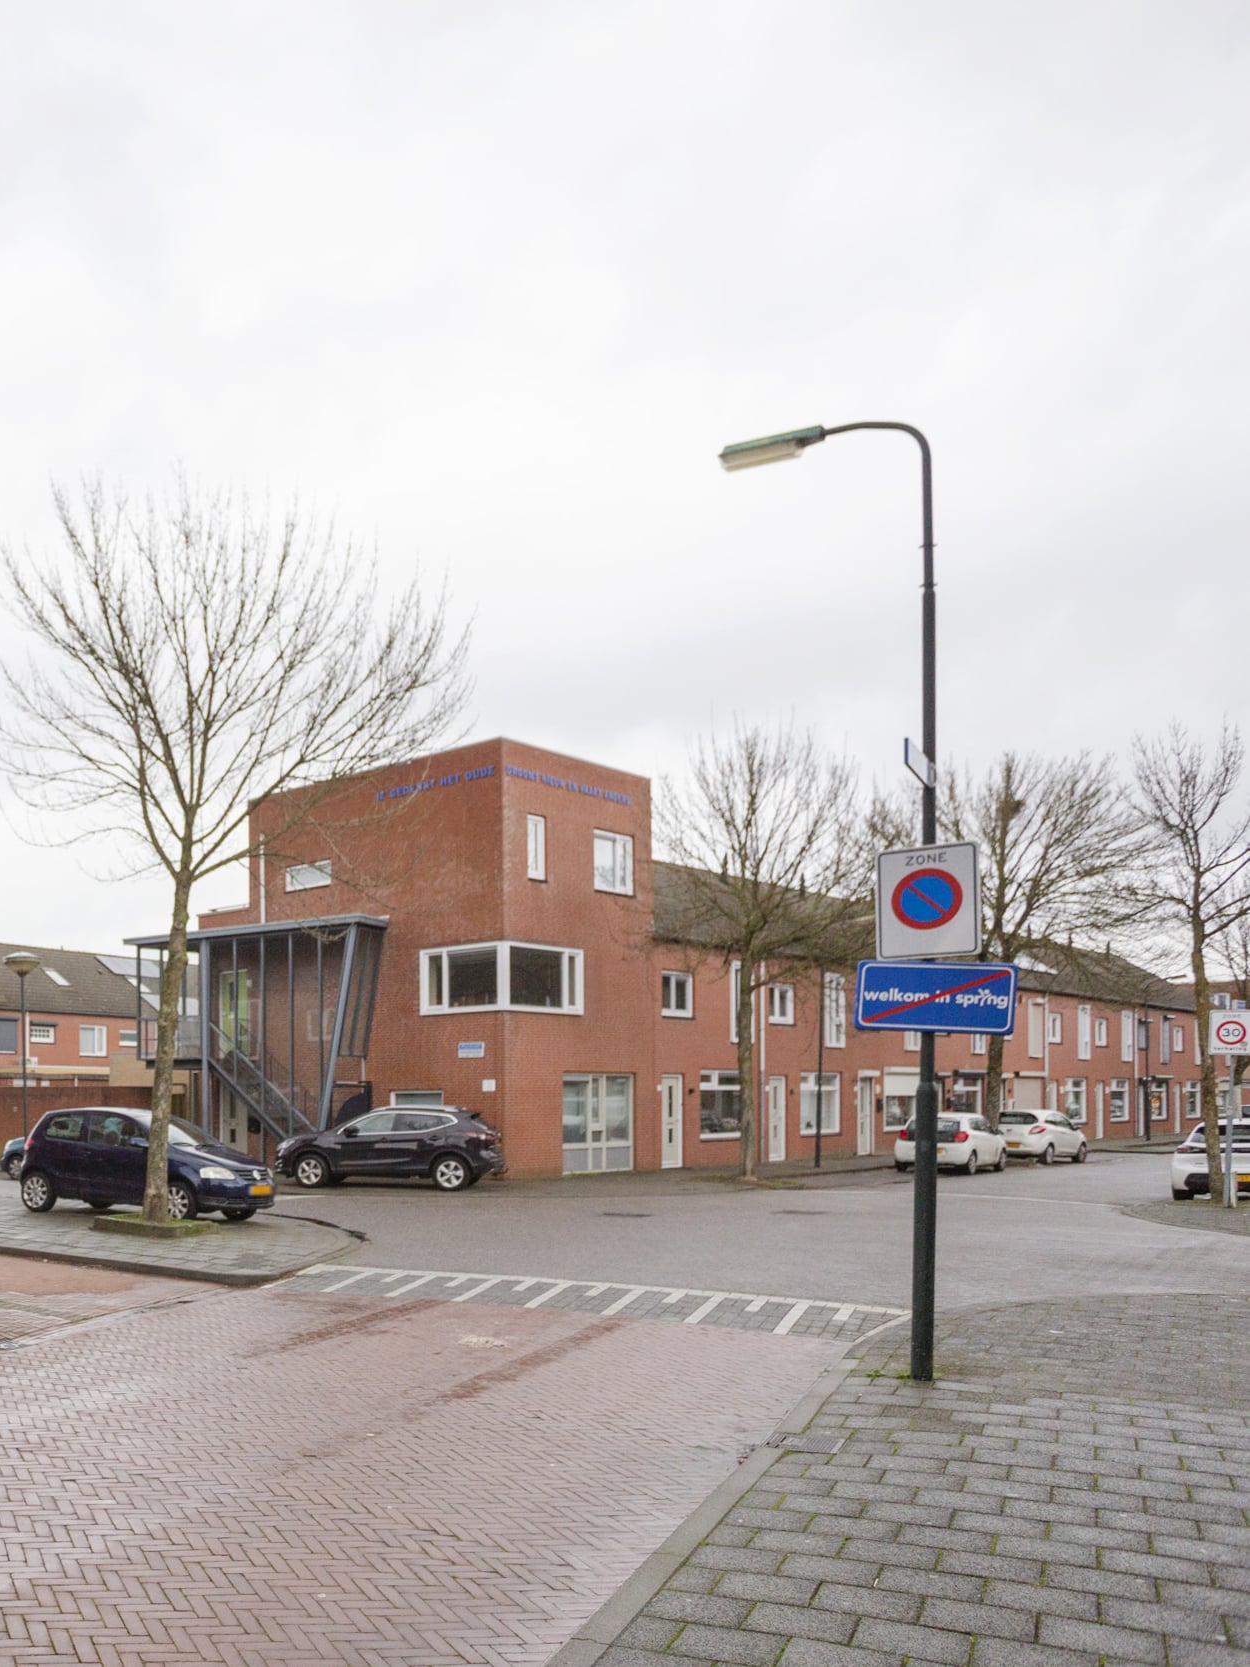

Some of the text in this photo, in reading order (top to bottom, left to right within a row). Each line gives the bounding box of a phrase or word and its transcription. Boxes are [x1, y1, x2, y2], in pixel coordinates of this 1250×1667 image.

[905, 852, 947, 867] ZONE
[863, 987, 930, 1003] welkom
[935, 990, 950, 1004] in
[1222, 1028, 1241, 1038] 30
